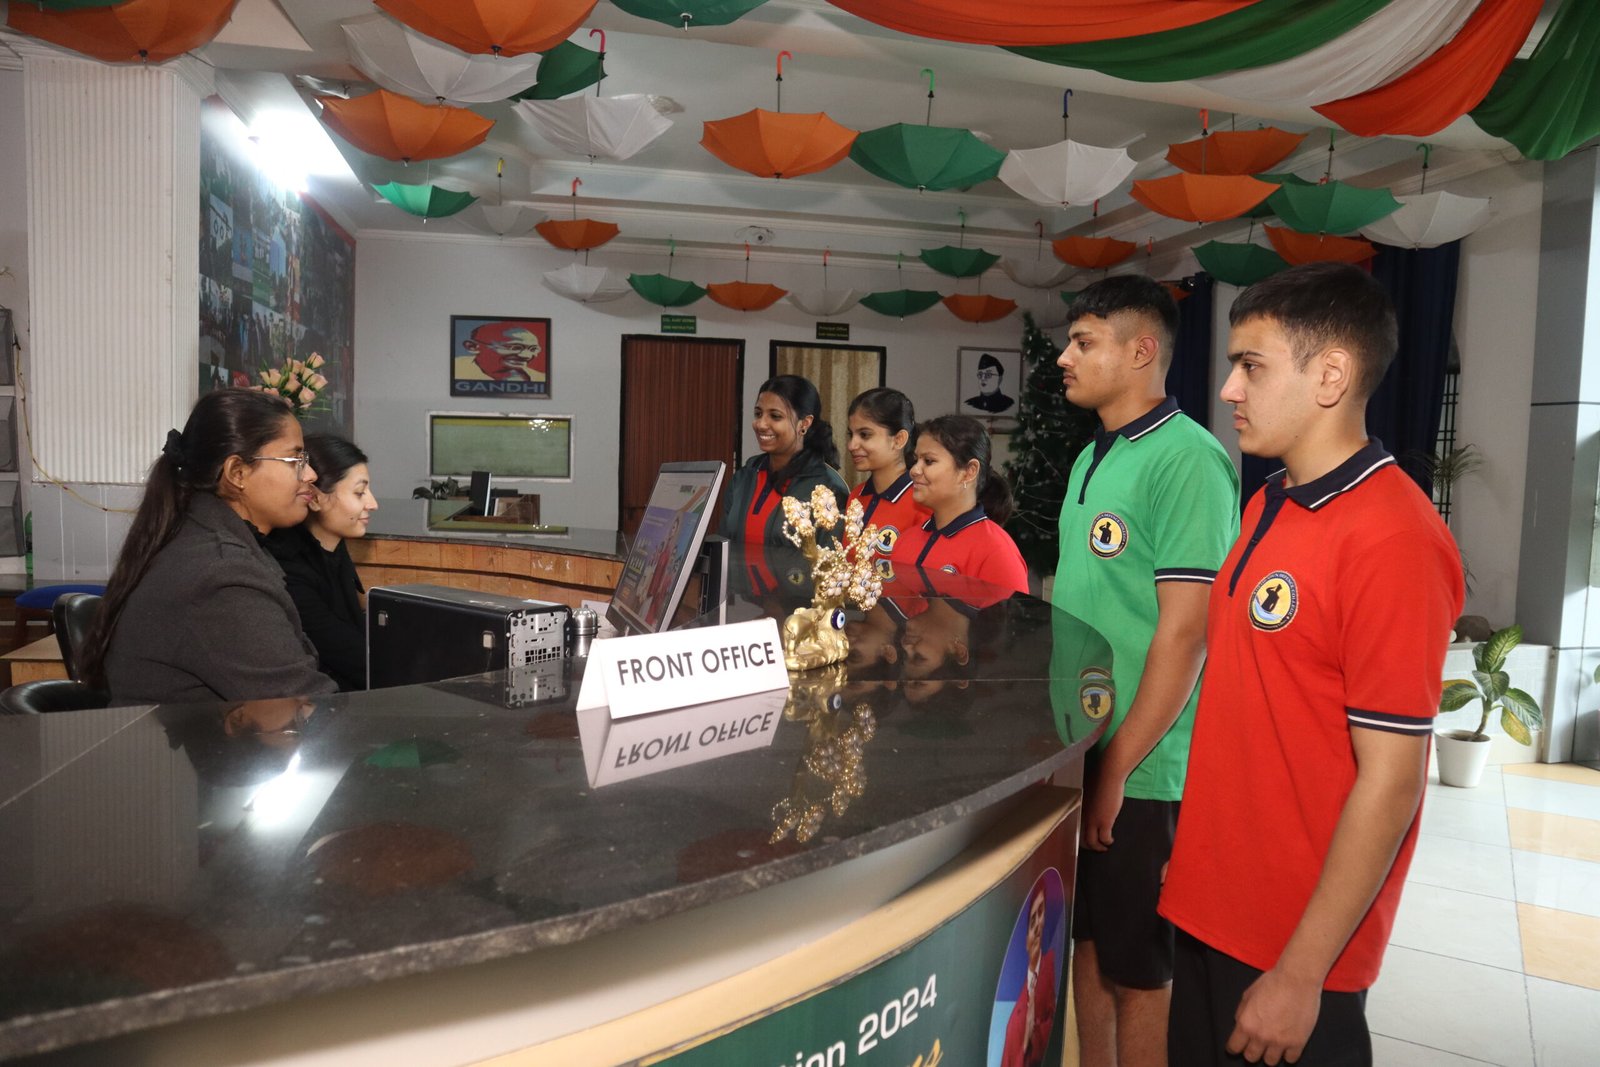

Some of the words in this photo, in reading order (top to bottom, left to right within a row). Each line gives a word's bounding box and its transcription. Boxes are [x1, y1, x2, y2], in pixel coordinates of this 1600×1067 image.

[455, 381, 545, 393] GANDHI
[617, 652, 693, 686] FRONT
[701, 642, 776, 674] OFFICE
[858, 973, 937, 1056] 2024
